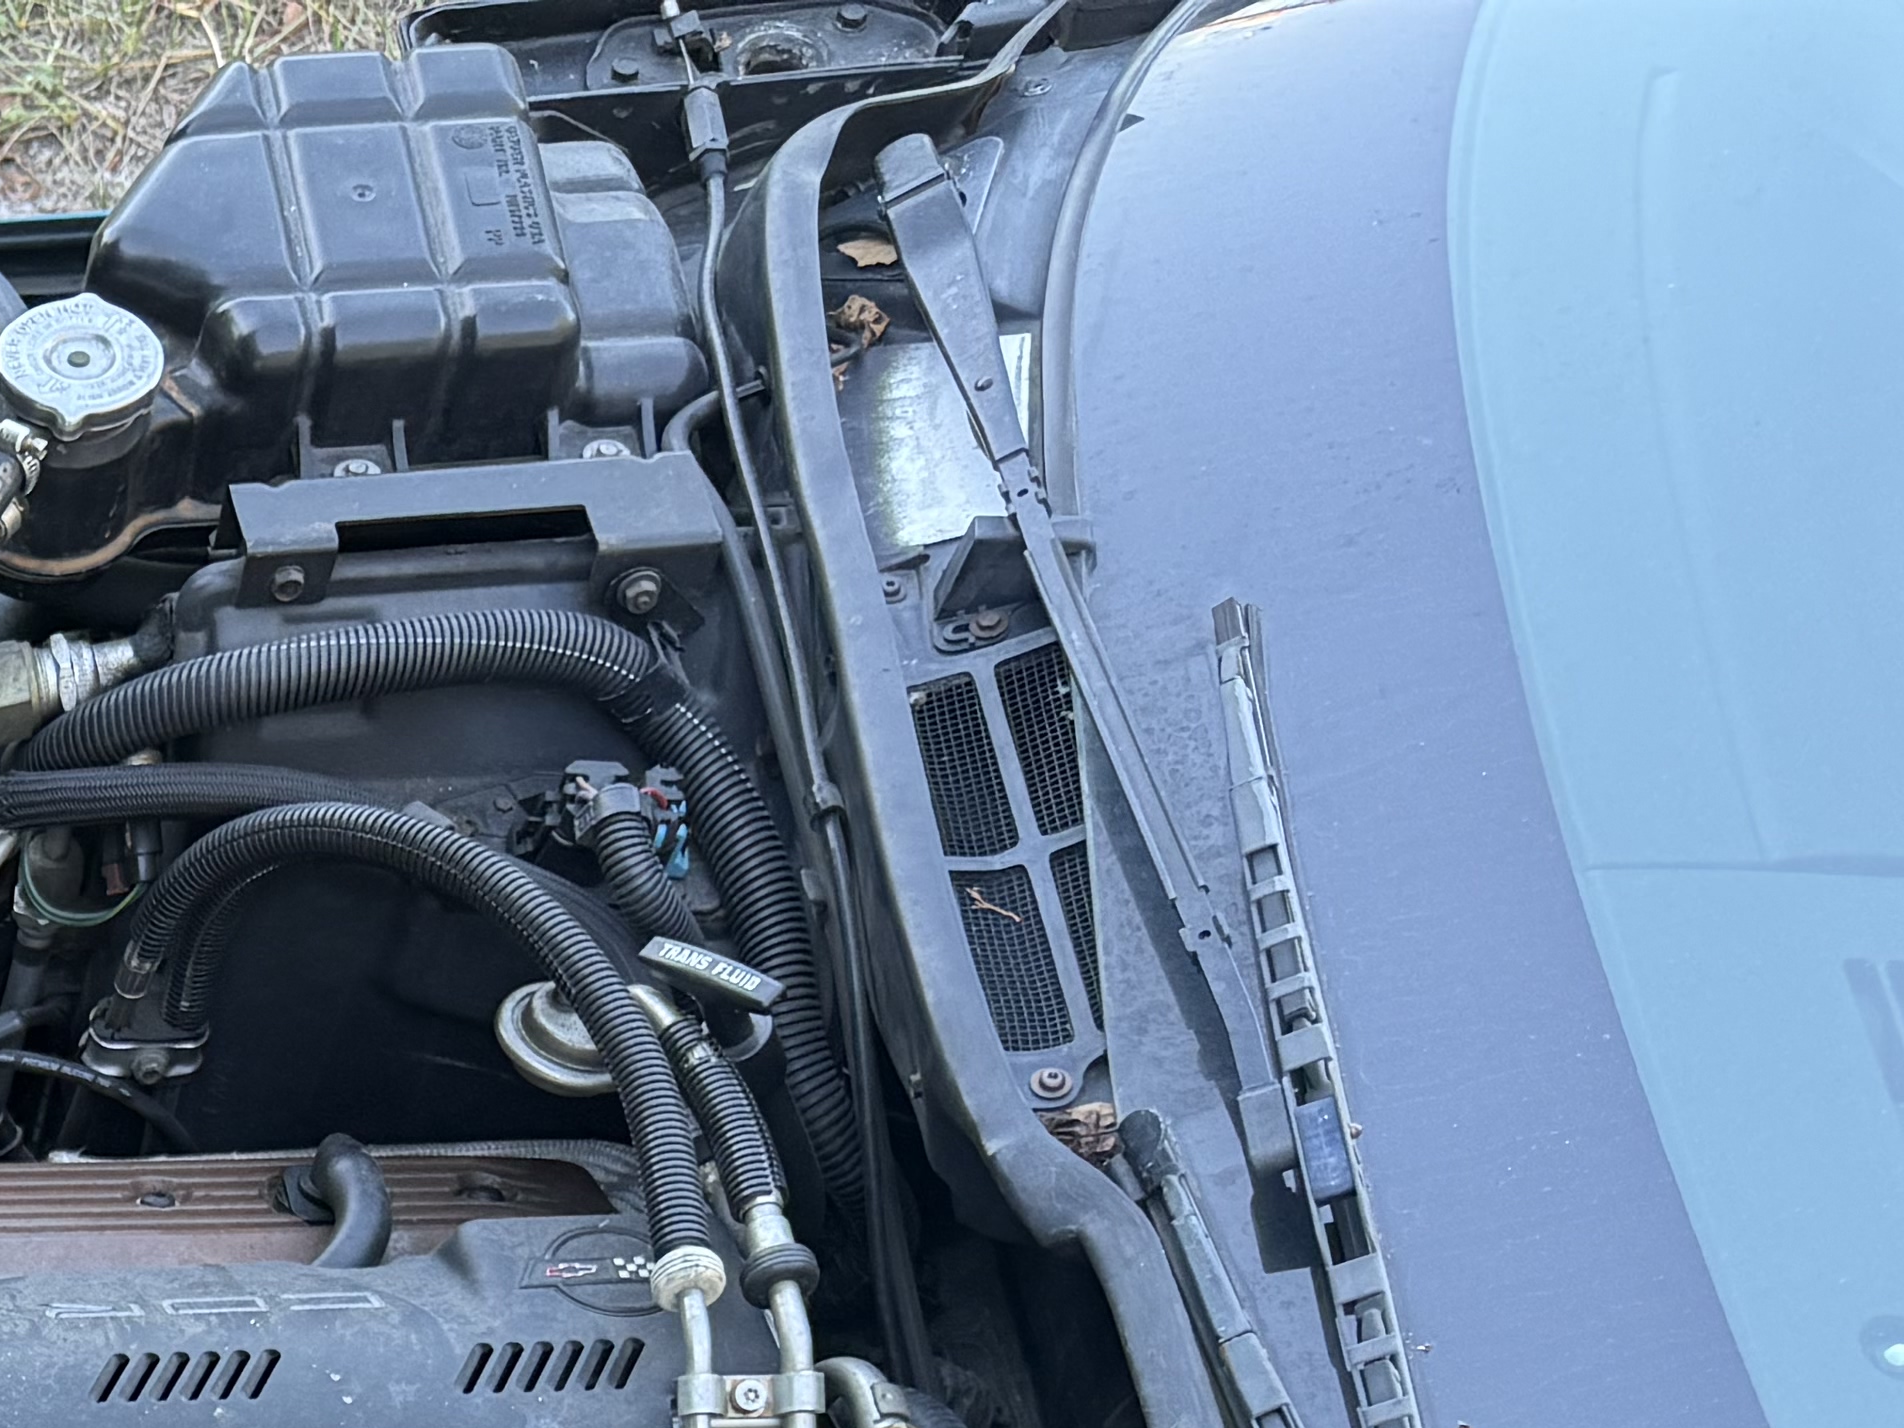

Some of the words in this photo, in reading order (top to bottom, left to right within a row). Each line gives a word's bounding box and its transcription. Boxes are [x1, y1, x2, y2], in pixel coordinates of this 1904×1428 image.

[2, 331, 32, 383] NEVER
[658, 940, 711, 973] TRANS
[711, 958, 762, 994] FLUID
